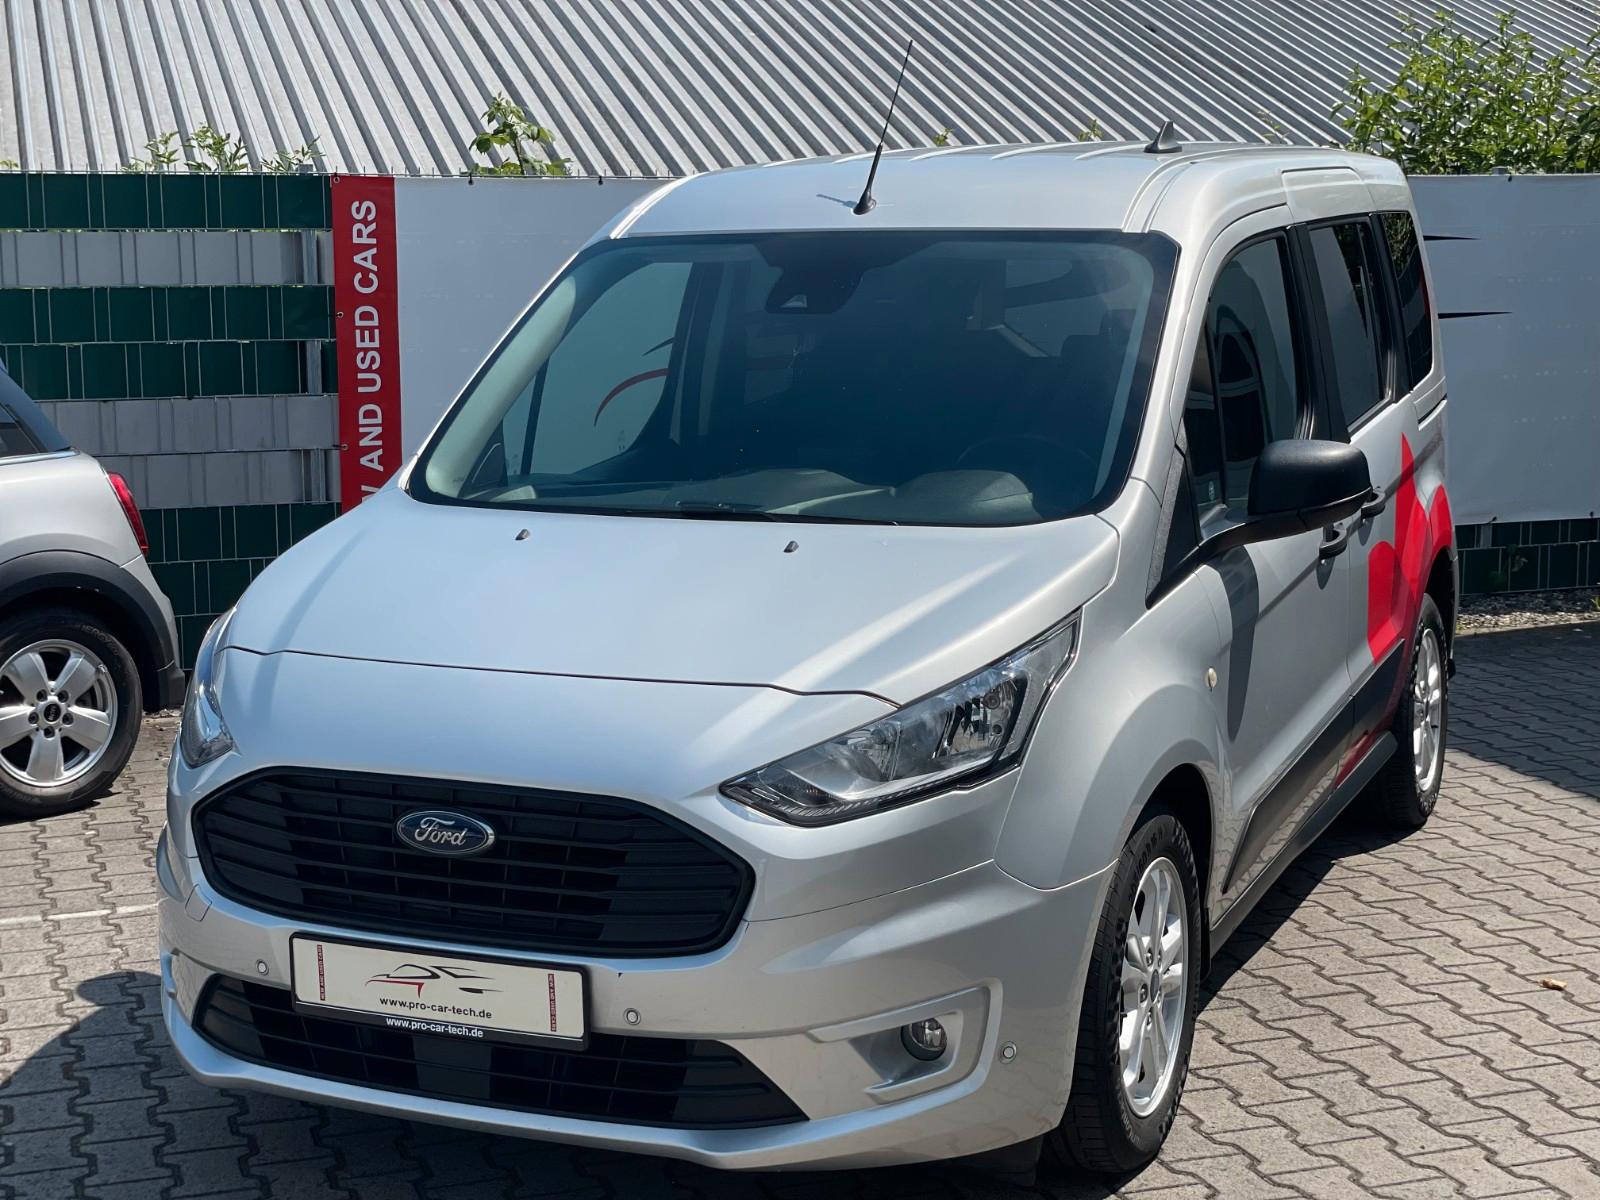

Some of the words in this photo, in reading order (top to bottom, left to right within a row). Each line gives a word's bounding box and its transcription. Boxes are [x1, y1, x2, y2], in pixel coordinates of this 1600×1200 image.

[351, 200, 379, 294] CARS
[354, 305, 382, 393] USED
[358, 403, 384, 472] AND
[414, 817, 468, 846] Ford
[379, 997, 493, 1020] www.pro-car-tech.de
[386, 1017, 484, 1038] www.pro-car-tech.de
